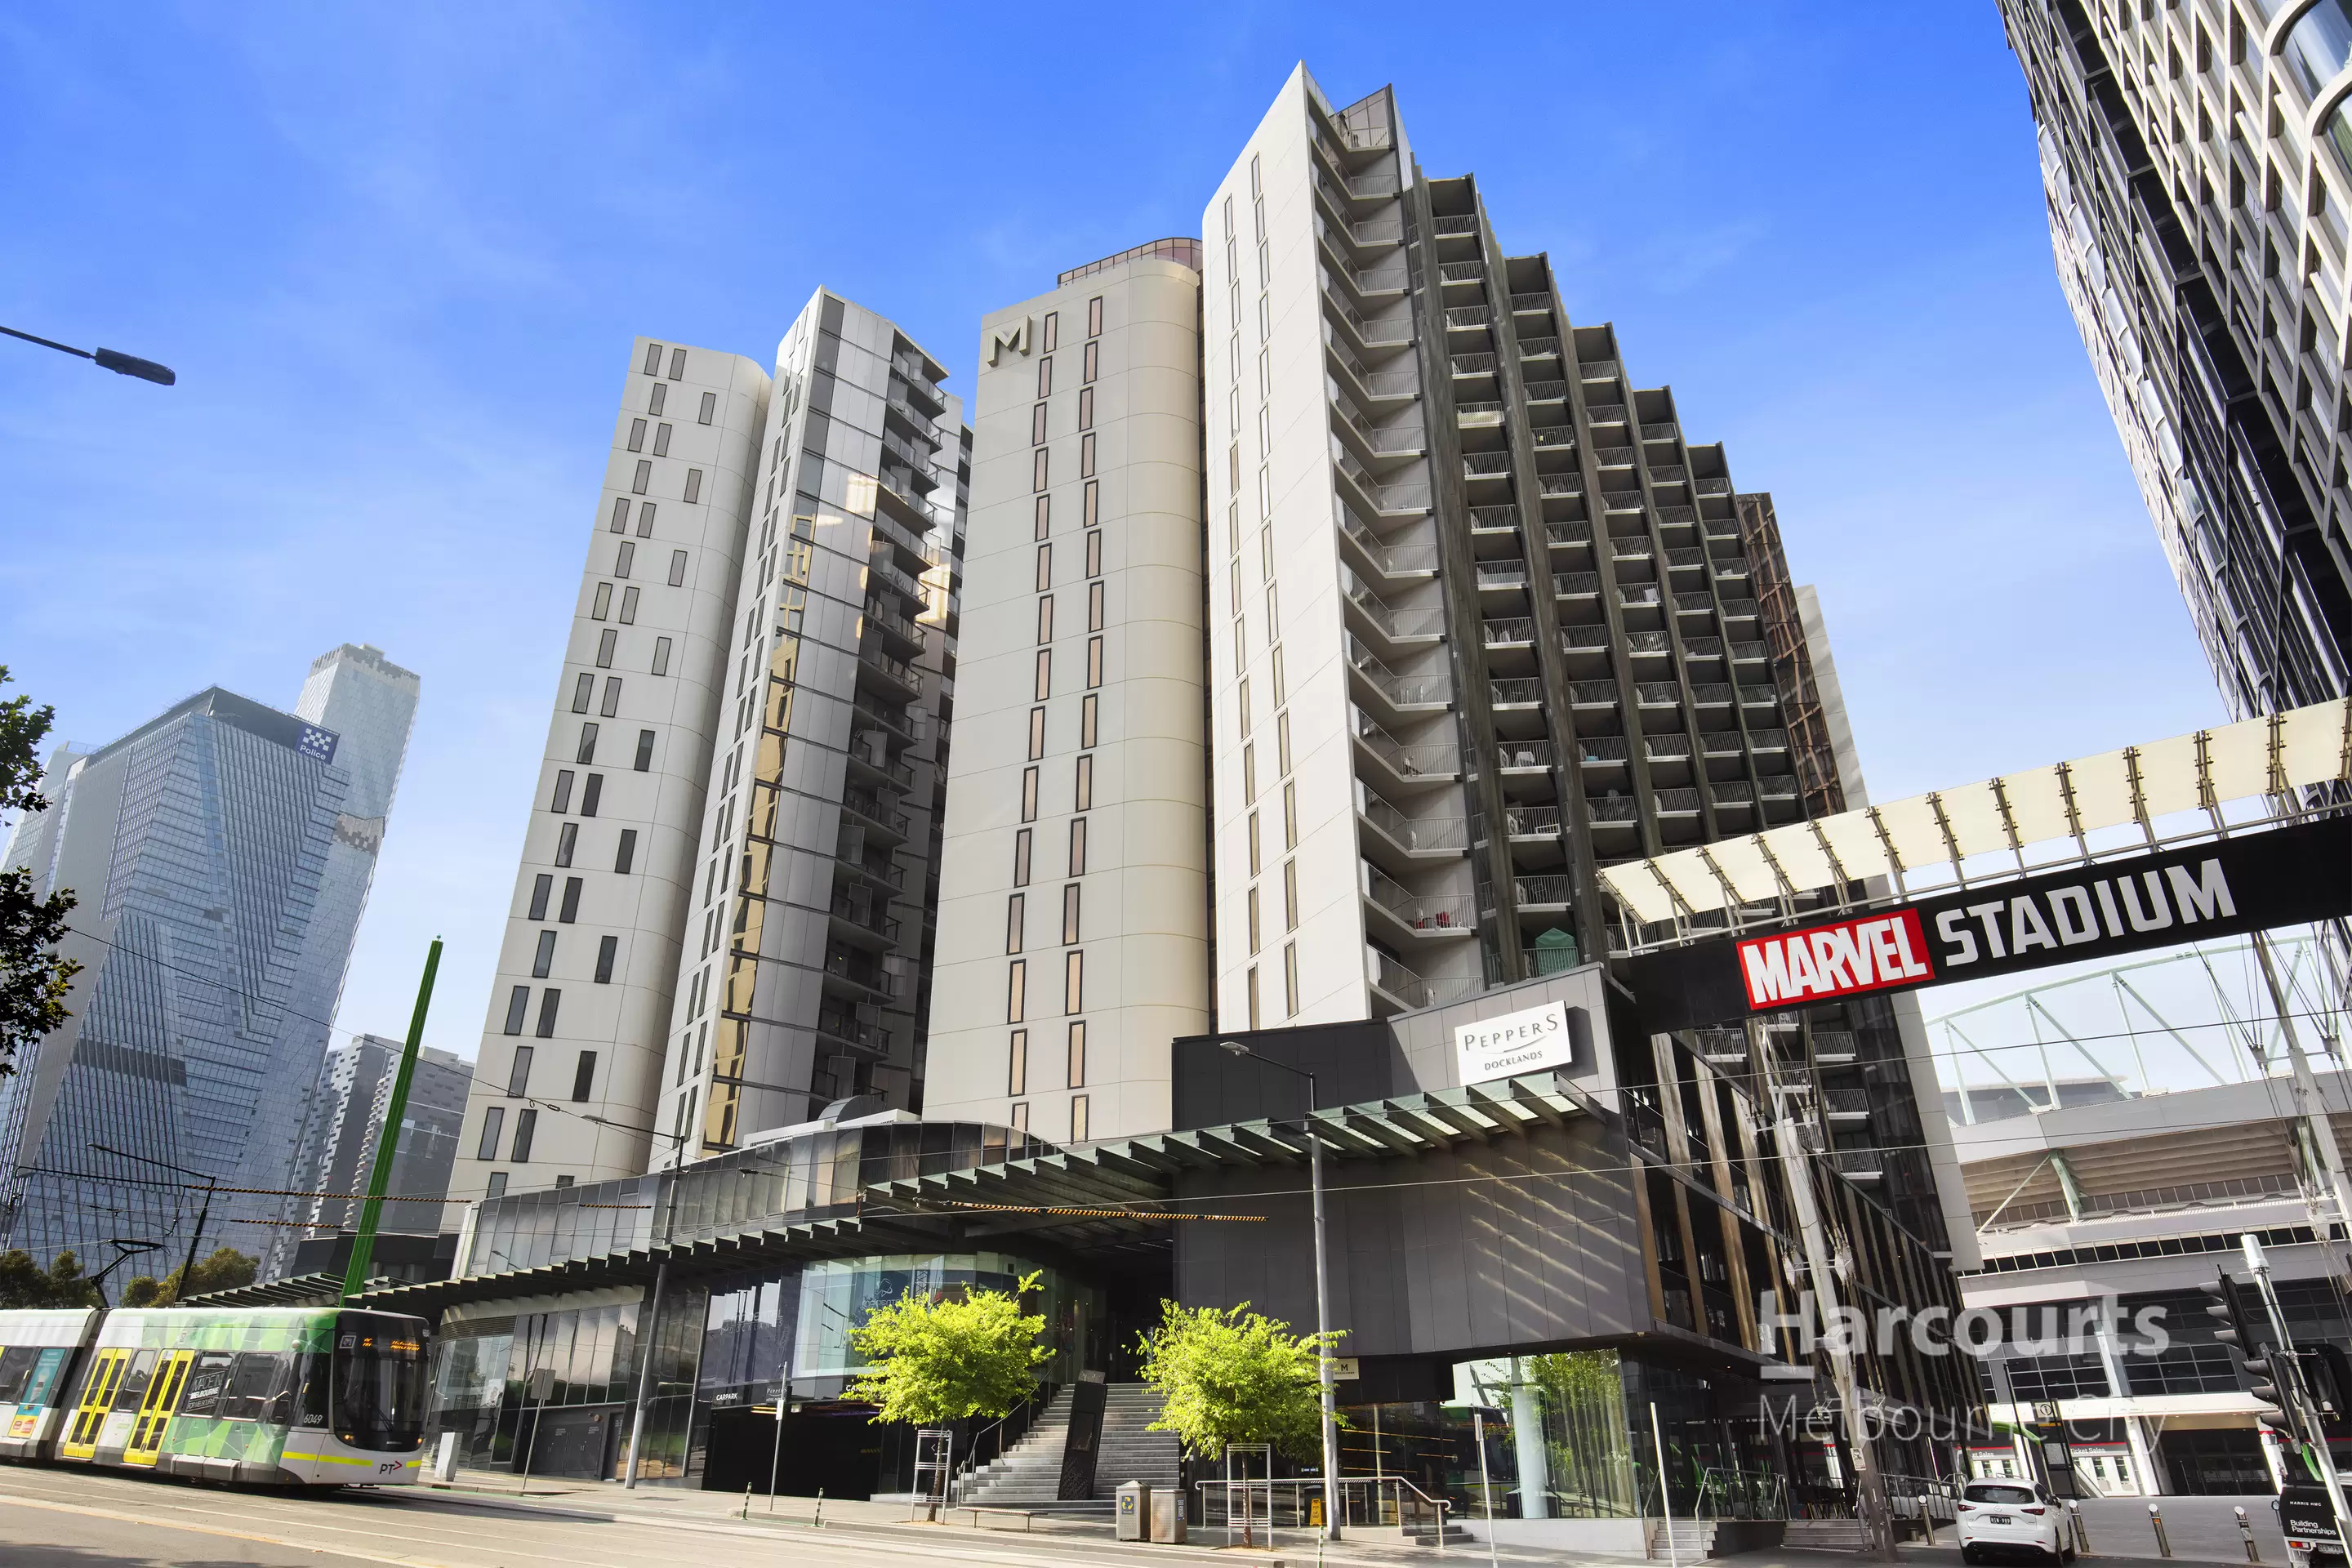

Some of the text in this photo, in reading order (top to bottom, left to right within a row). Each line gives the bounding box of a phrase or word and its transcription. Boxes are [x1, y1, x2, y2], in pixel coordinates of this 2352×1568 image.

[300, 744, 327, 760] Police
[1742, 858, 2238, 1005] MARVEL STADIUM
[1484, 1050, 1543, 1071] DOCKLANDS
[716, 1392, 737, 1401] CARPARK
[303, 1414, 323, 1424] 6049
[2290, 1519, 2319, 1529] Building
[2292, 1526, 2336, 1535] Partnerships
